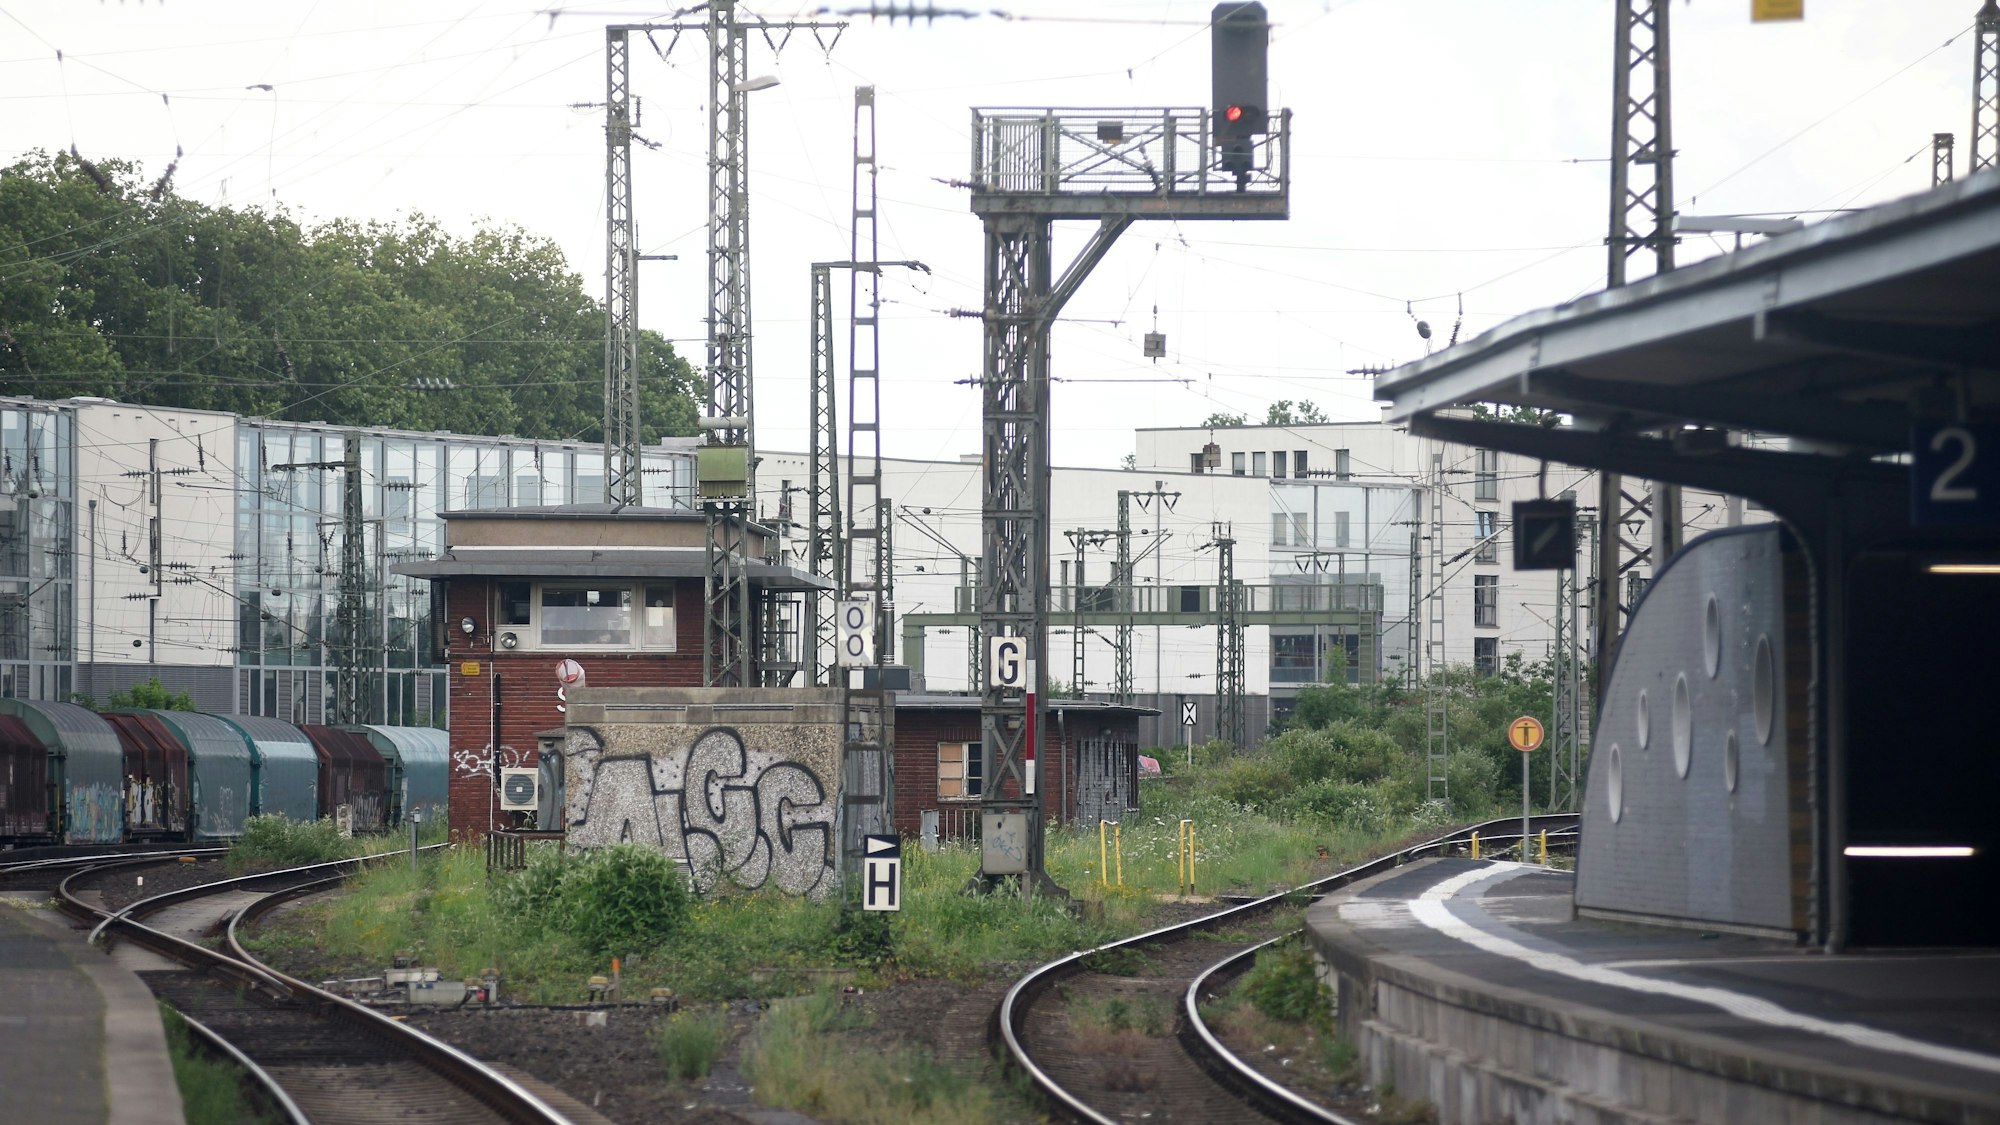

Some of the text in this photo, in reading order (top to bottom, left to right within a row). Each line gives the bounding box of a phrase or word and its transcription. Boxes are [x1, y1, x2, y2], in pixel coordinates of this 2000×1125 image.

[1930, 427, 1977, 501] 2
[998, 642, 1019, 685] G
[868, 862, 896, 906] H
